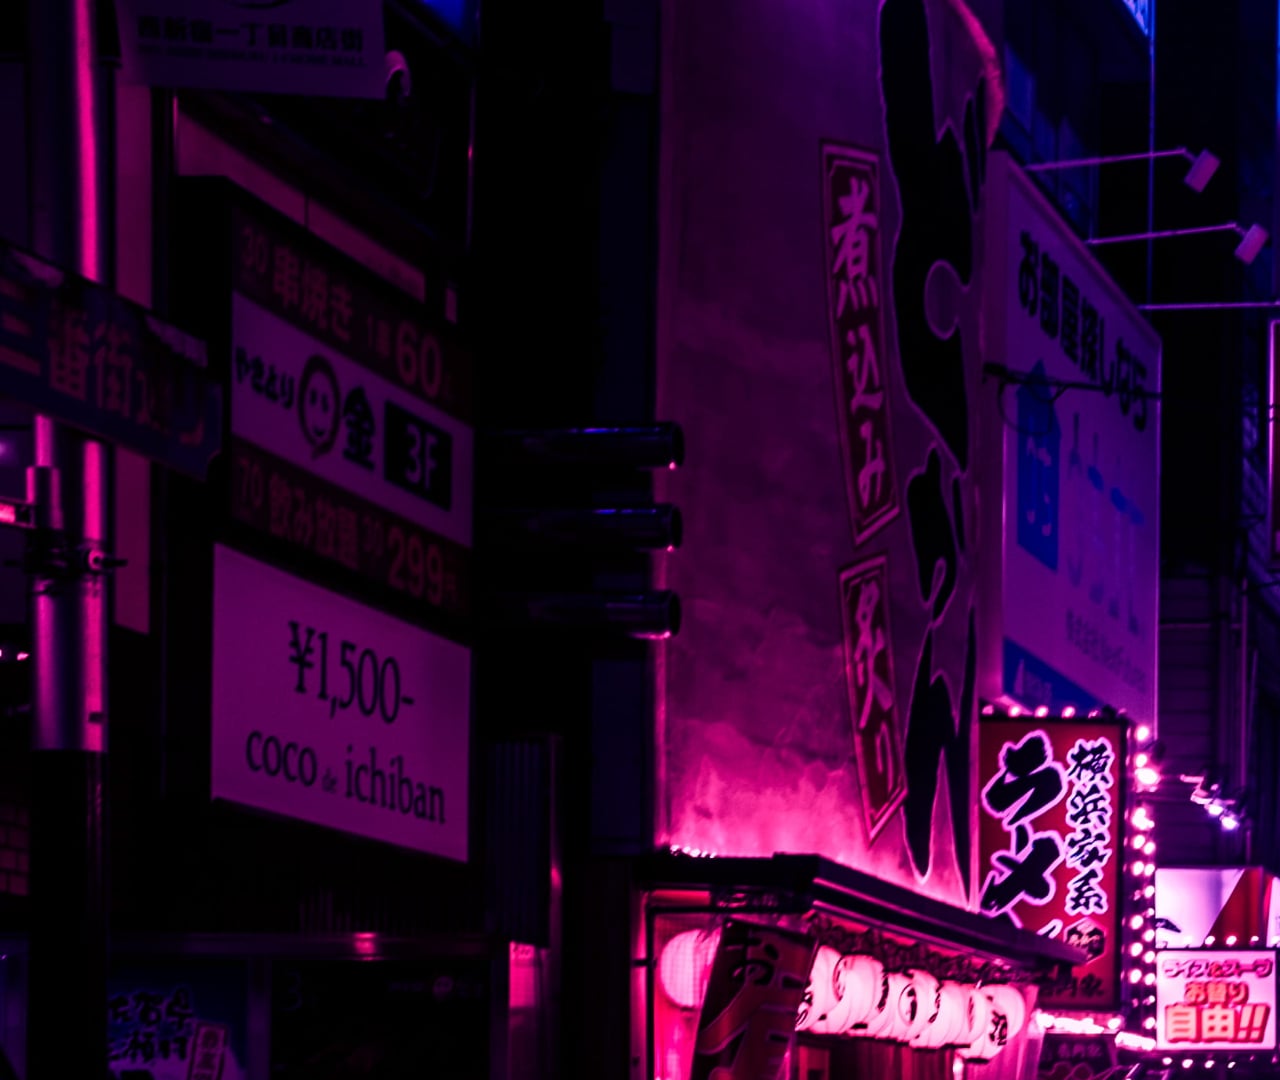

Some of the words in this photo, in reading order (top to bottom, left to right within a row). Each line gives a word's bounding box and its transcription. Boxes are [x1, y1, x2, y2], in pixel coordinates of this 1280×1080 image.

[402, 421, 436, 492] 3F
[244, 729, 318, 787] coco
[343, 743, 447, 826] ichiban
[1164, 1003, 1272, 1044] 自由!!
